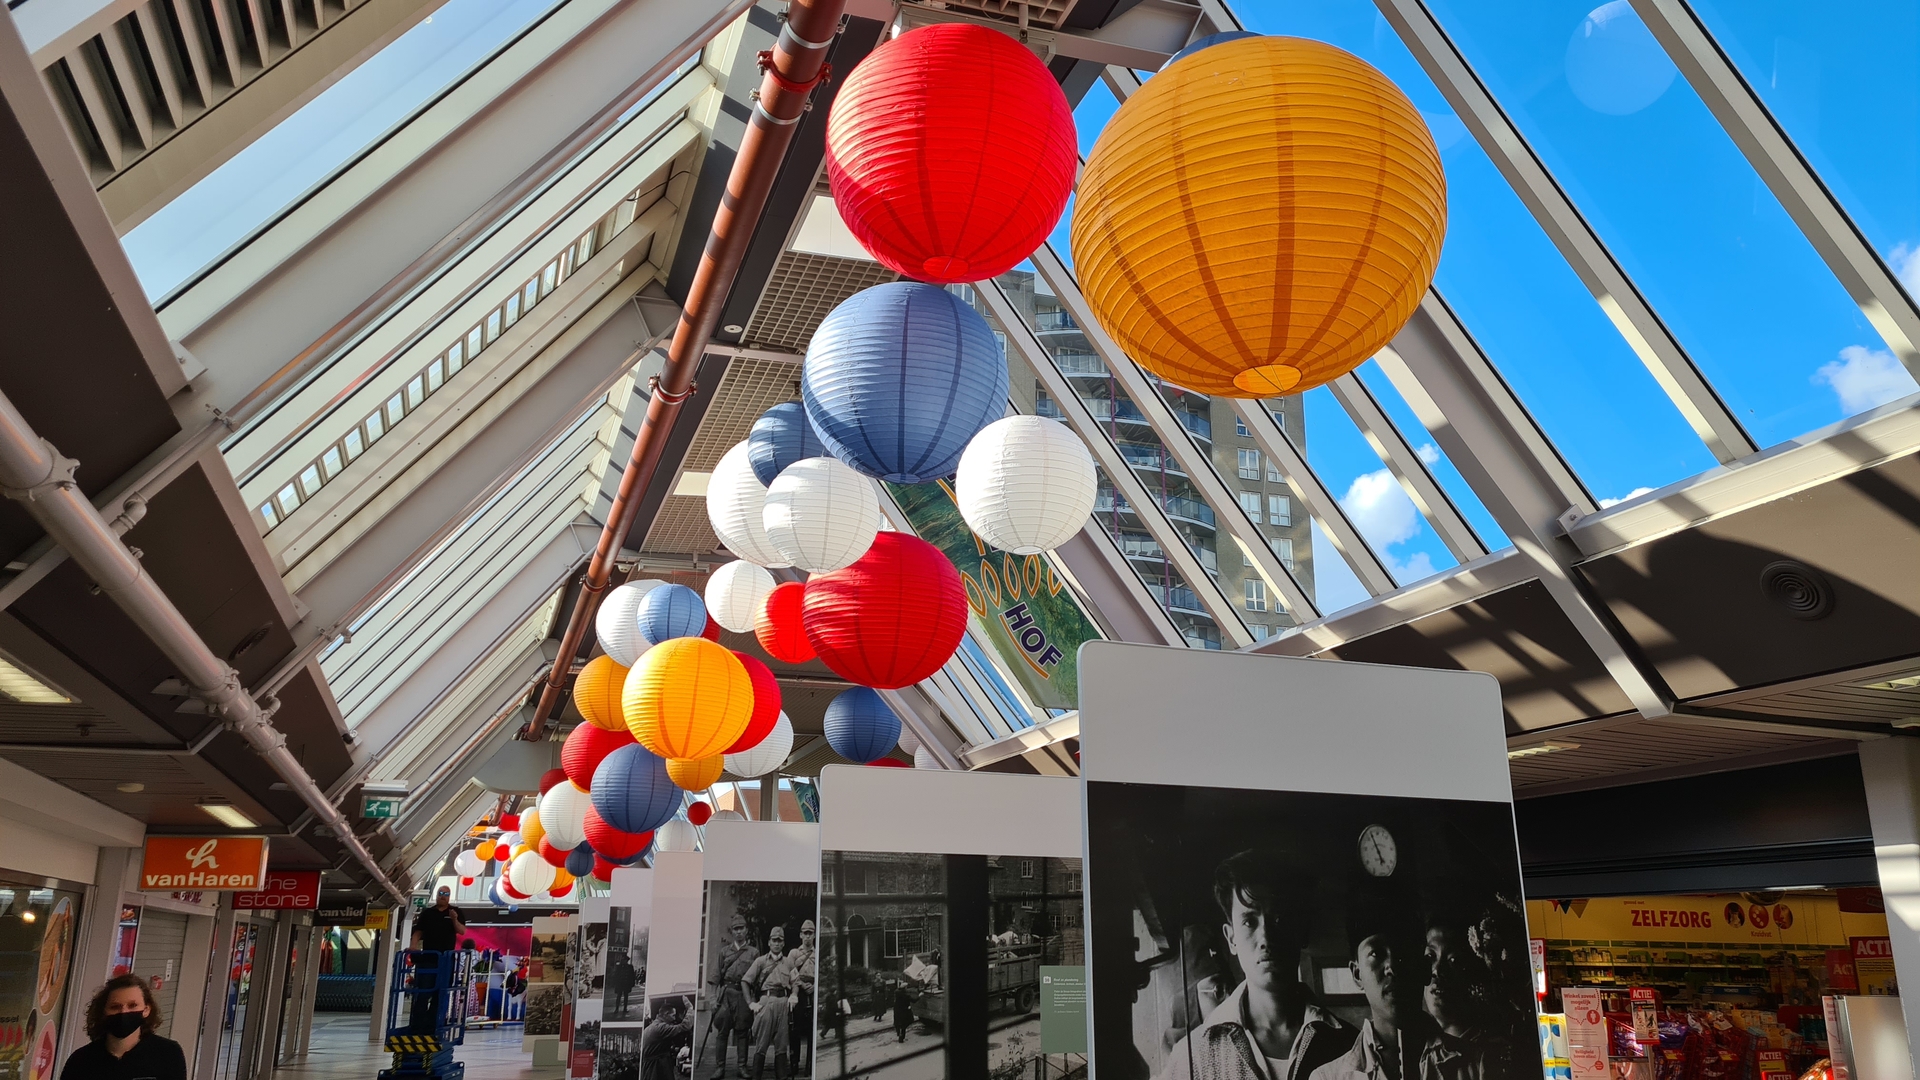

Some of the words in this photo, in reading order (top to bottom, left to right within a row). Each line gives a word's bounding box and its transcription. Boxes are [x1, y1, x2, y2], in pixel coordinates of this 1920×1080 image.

[1003, 602, 1063, 668] HOF
[238, 893, 311, 907] stone
[1630, 909, 1712, 929] ZELFZORG
[1632, 989, 1653, 999] ACTIE!
[1759, 1051, 1782, 1061] ACTIE!
